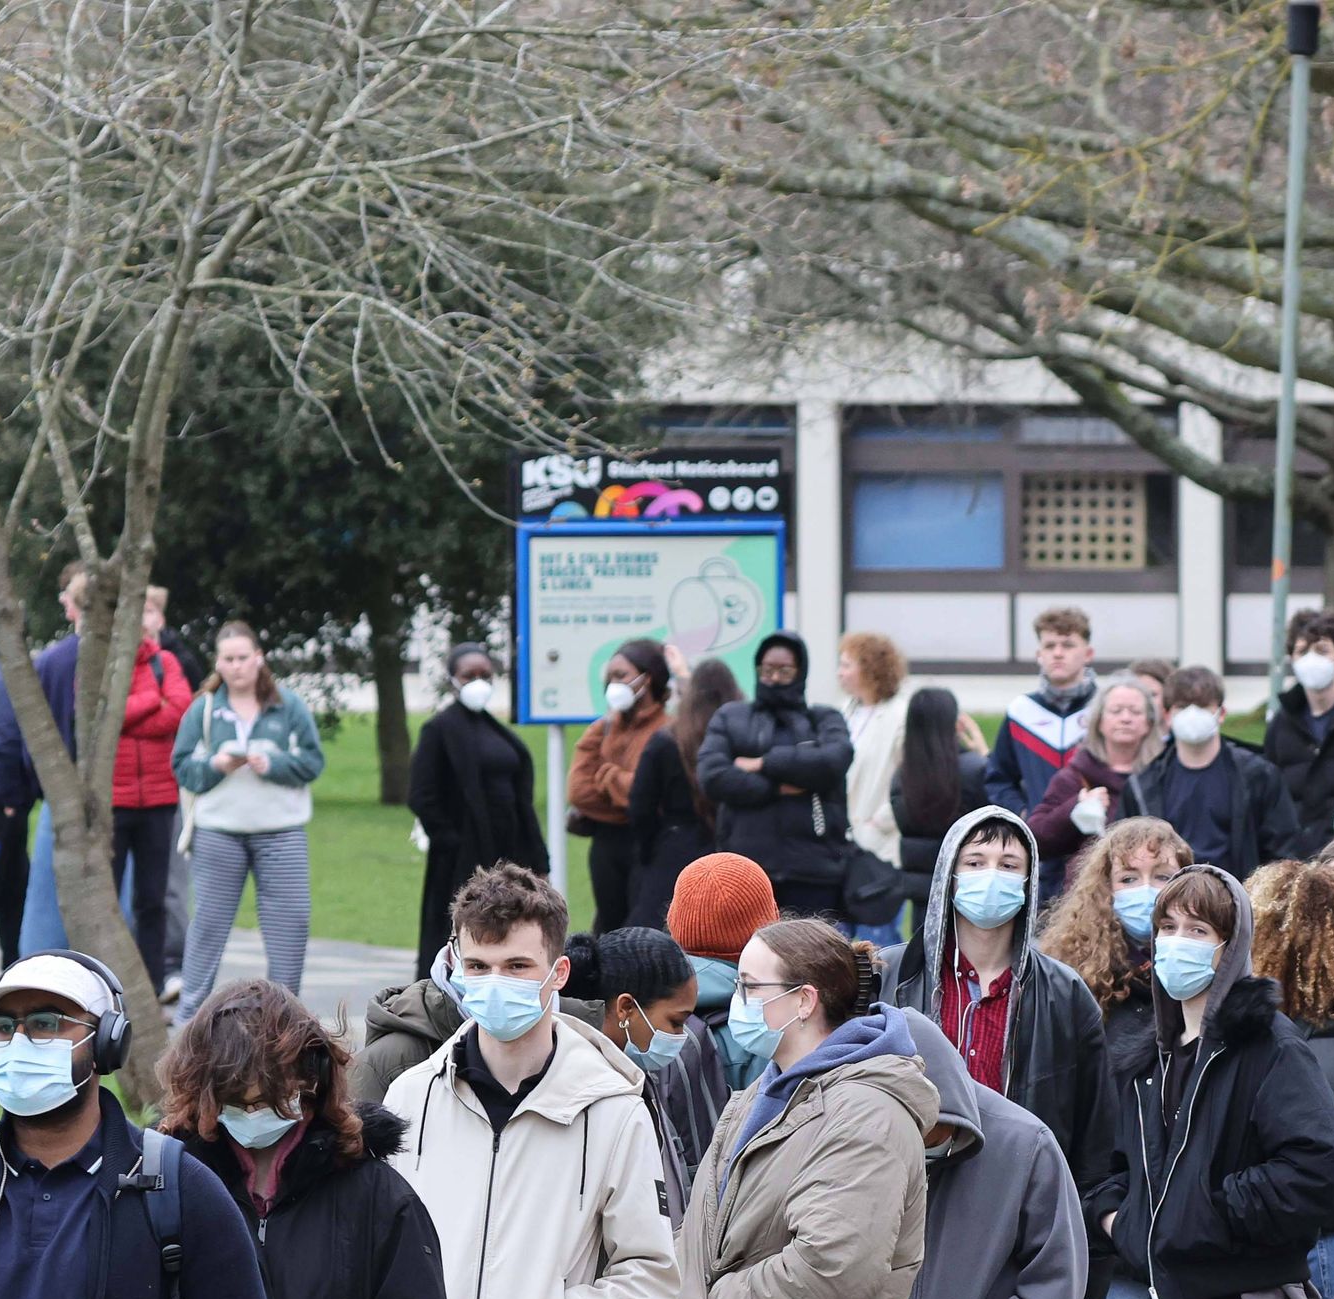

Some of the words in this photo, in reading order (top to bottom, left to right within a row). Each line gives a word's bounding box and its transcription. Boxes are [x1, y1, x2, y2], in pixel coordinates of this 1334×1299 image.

[522, 454, 602, 488] KSU
[608, 459, 673, 478] Student
[675, 459, 779, 478] Noticeboard
